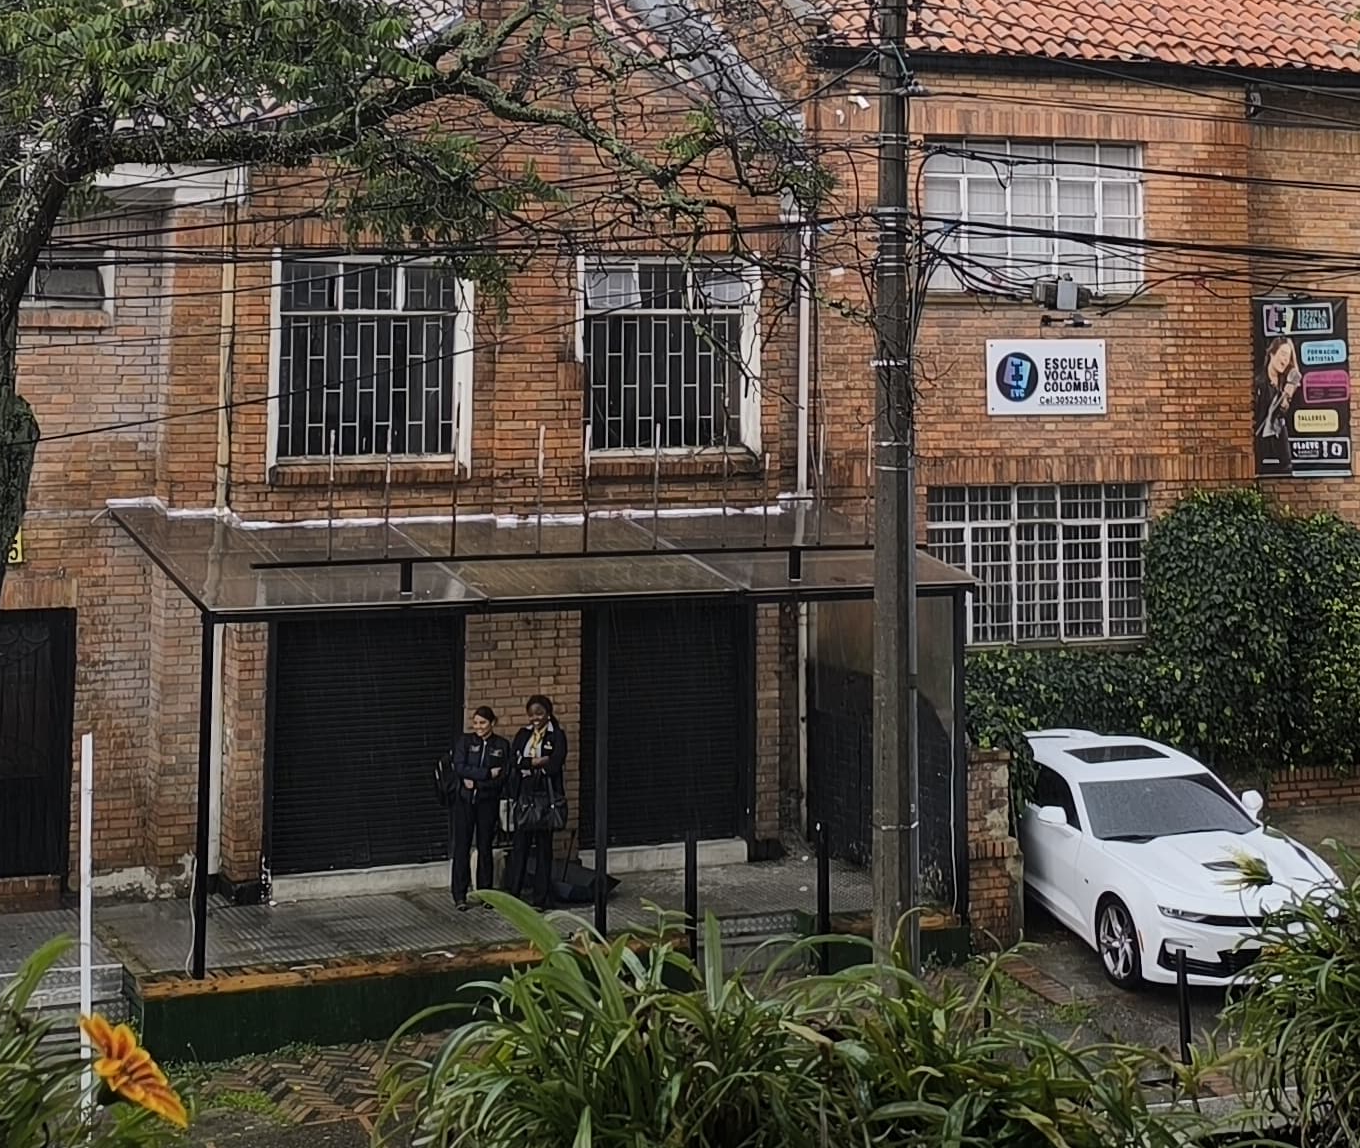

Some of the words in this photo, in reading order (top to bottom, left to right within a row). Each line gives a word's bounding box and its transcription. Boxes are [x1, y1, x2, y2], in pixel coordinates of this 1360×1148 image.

[1044, 358, 1099, 370] ESCUELA
[1044, 371, 1081, 381] VOCAL
[1084, 370, 1099, 381] DE
[1043, 381, 1100, 393] COLOMBIA
[1009, 389, 1025, 398] EVC
